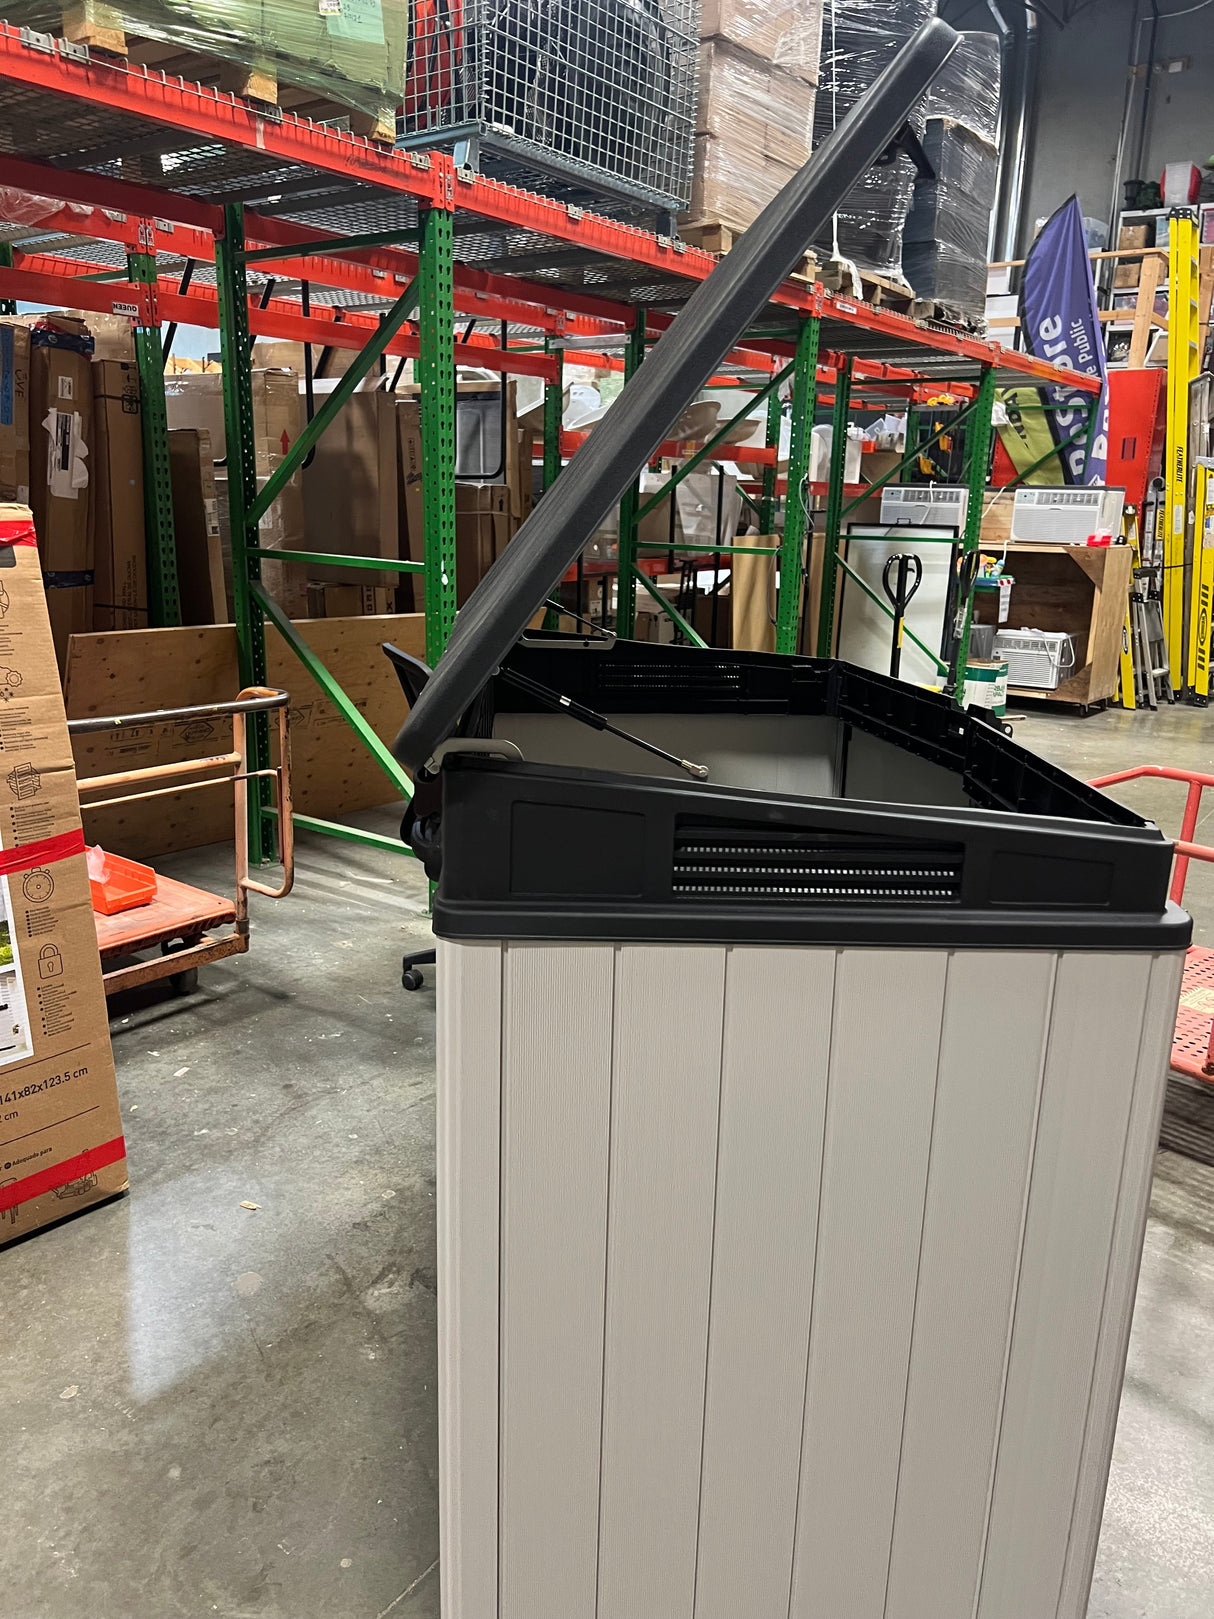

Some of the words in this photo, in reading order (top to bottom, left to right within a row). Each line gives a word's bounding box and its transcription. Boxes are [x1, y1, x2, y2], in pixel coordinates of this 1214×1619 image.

[112, 303, 137, 312] QUEEN
[1070, 318, 1093, 364] Public
[1176, 446, 1184, 483] FEATHERLITE
[0, 1071, 71, 1105] 141x82x123.5
[73, 1067, 88, 1079] cm
[4, 1111, 19, 1121] cm
